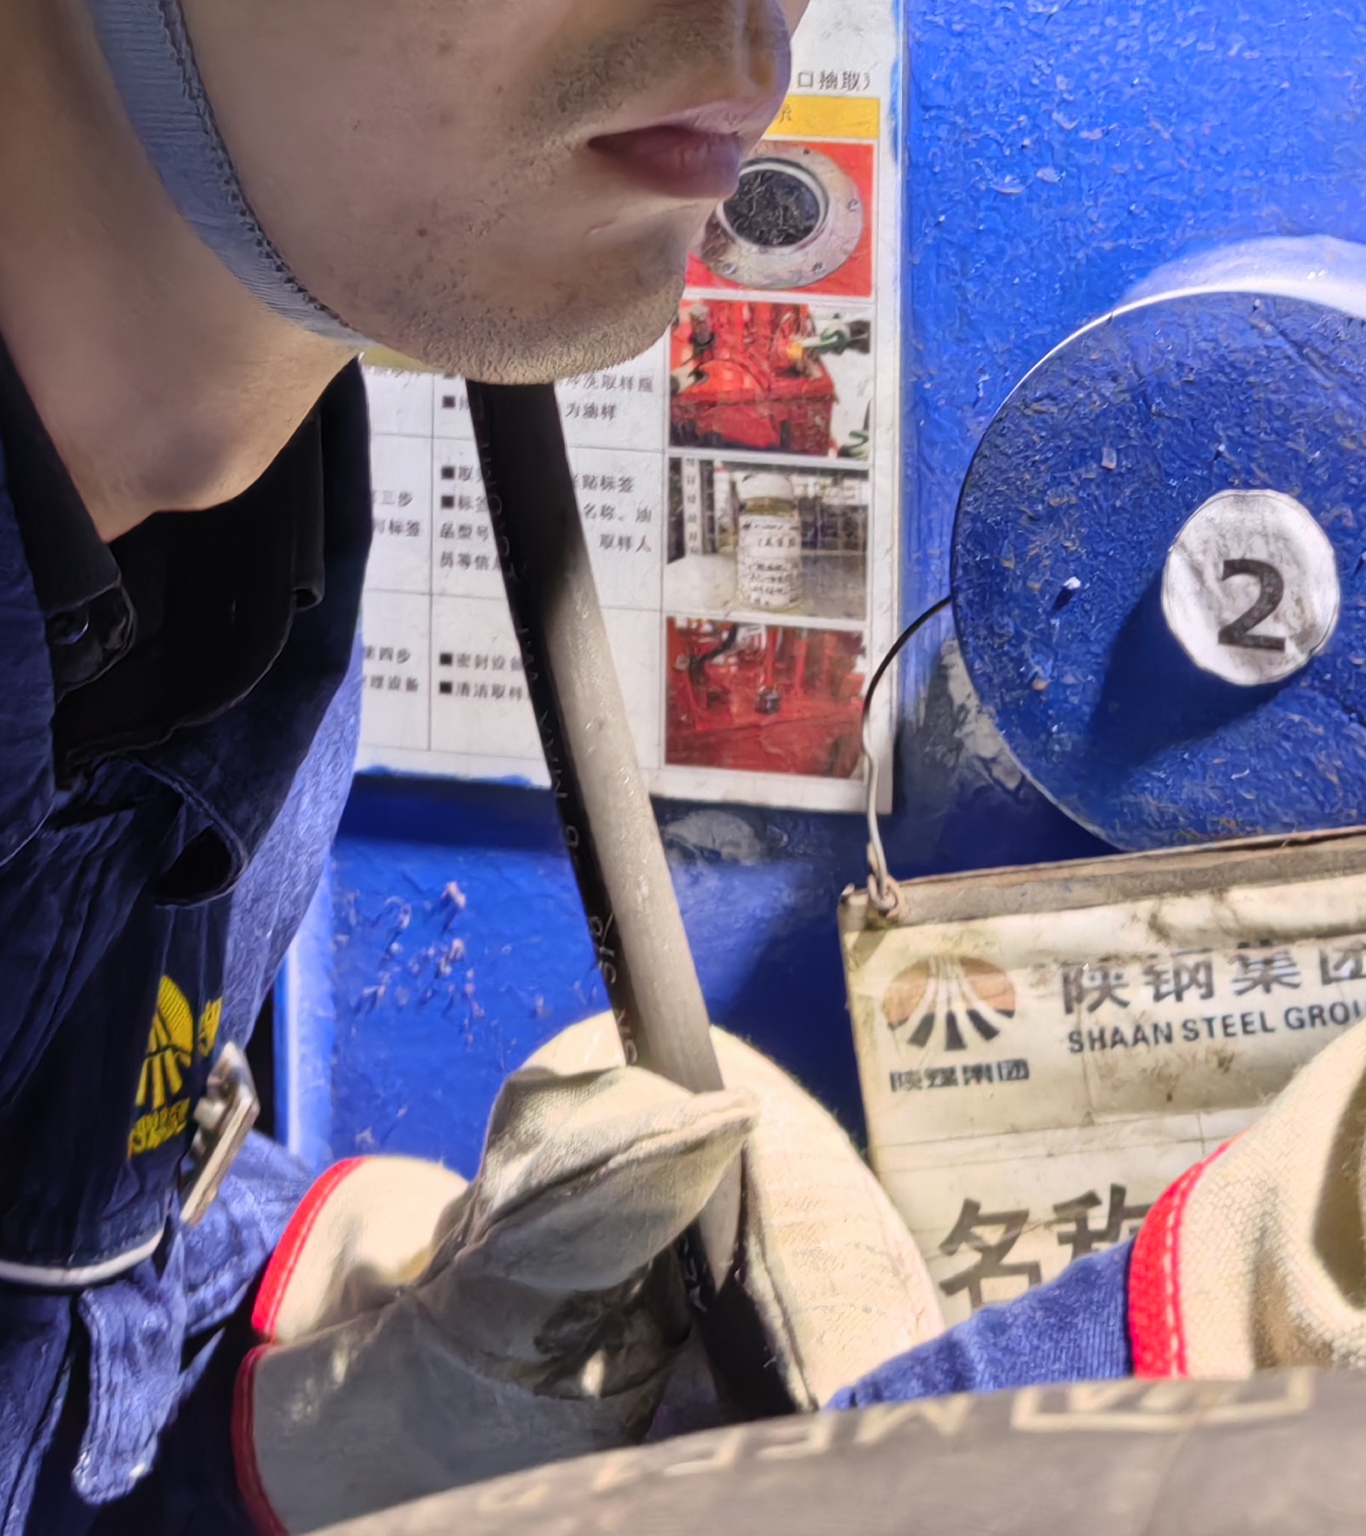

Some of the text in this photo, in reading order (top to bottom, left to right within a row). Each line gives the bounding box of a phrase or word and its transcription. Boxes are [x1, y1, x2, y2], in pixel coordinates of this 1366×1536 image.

[373, 490, 413, 507] 三步
[1217, 558, 1286, 652] 2
[1068, 1019, 1174, 1054] SHAAN
[1181, 1009, 1277, 1043] STEEL
